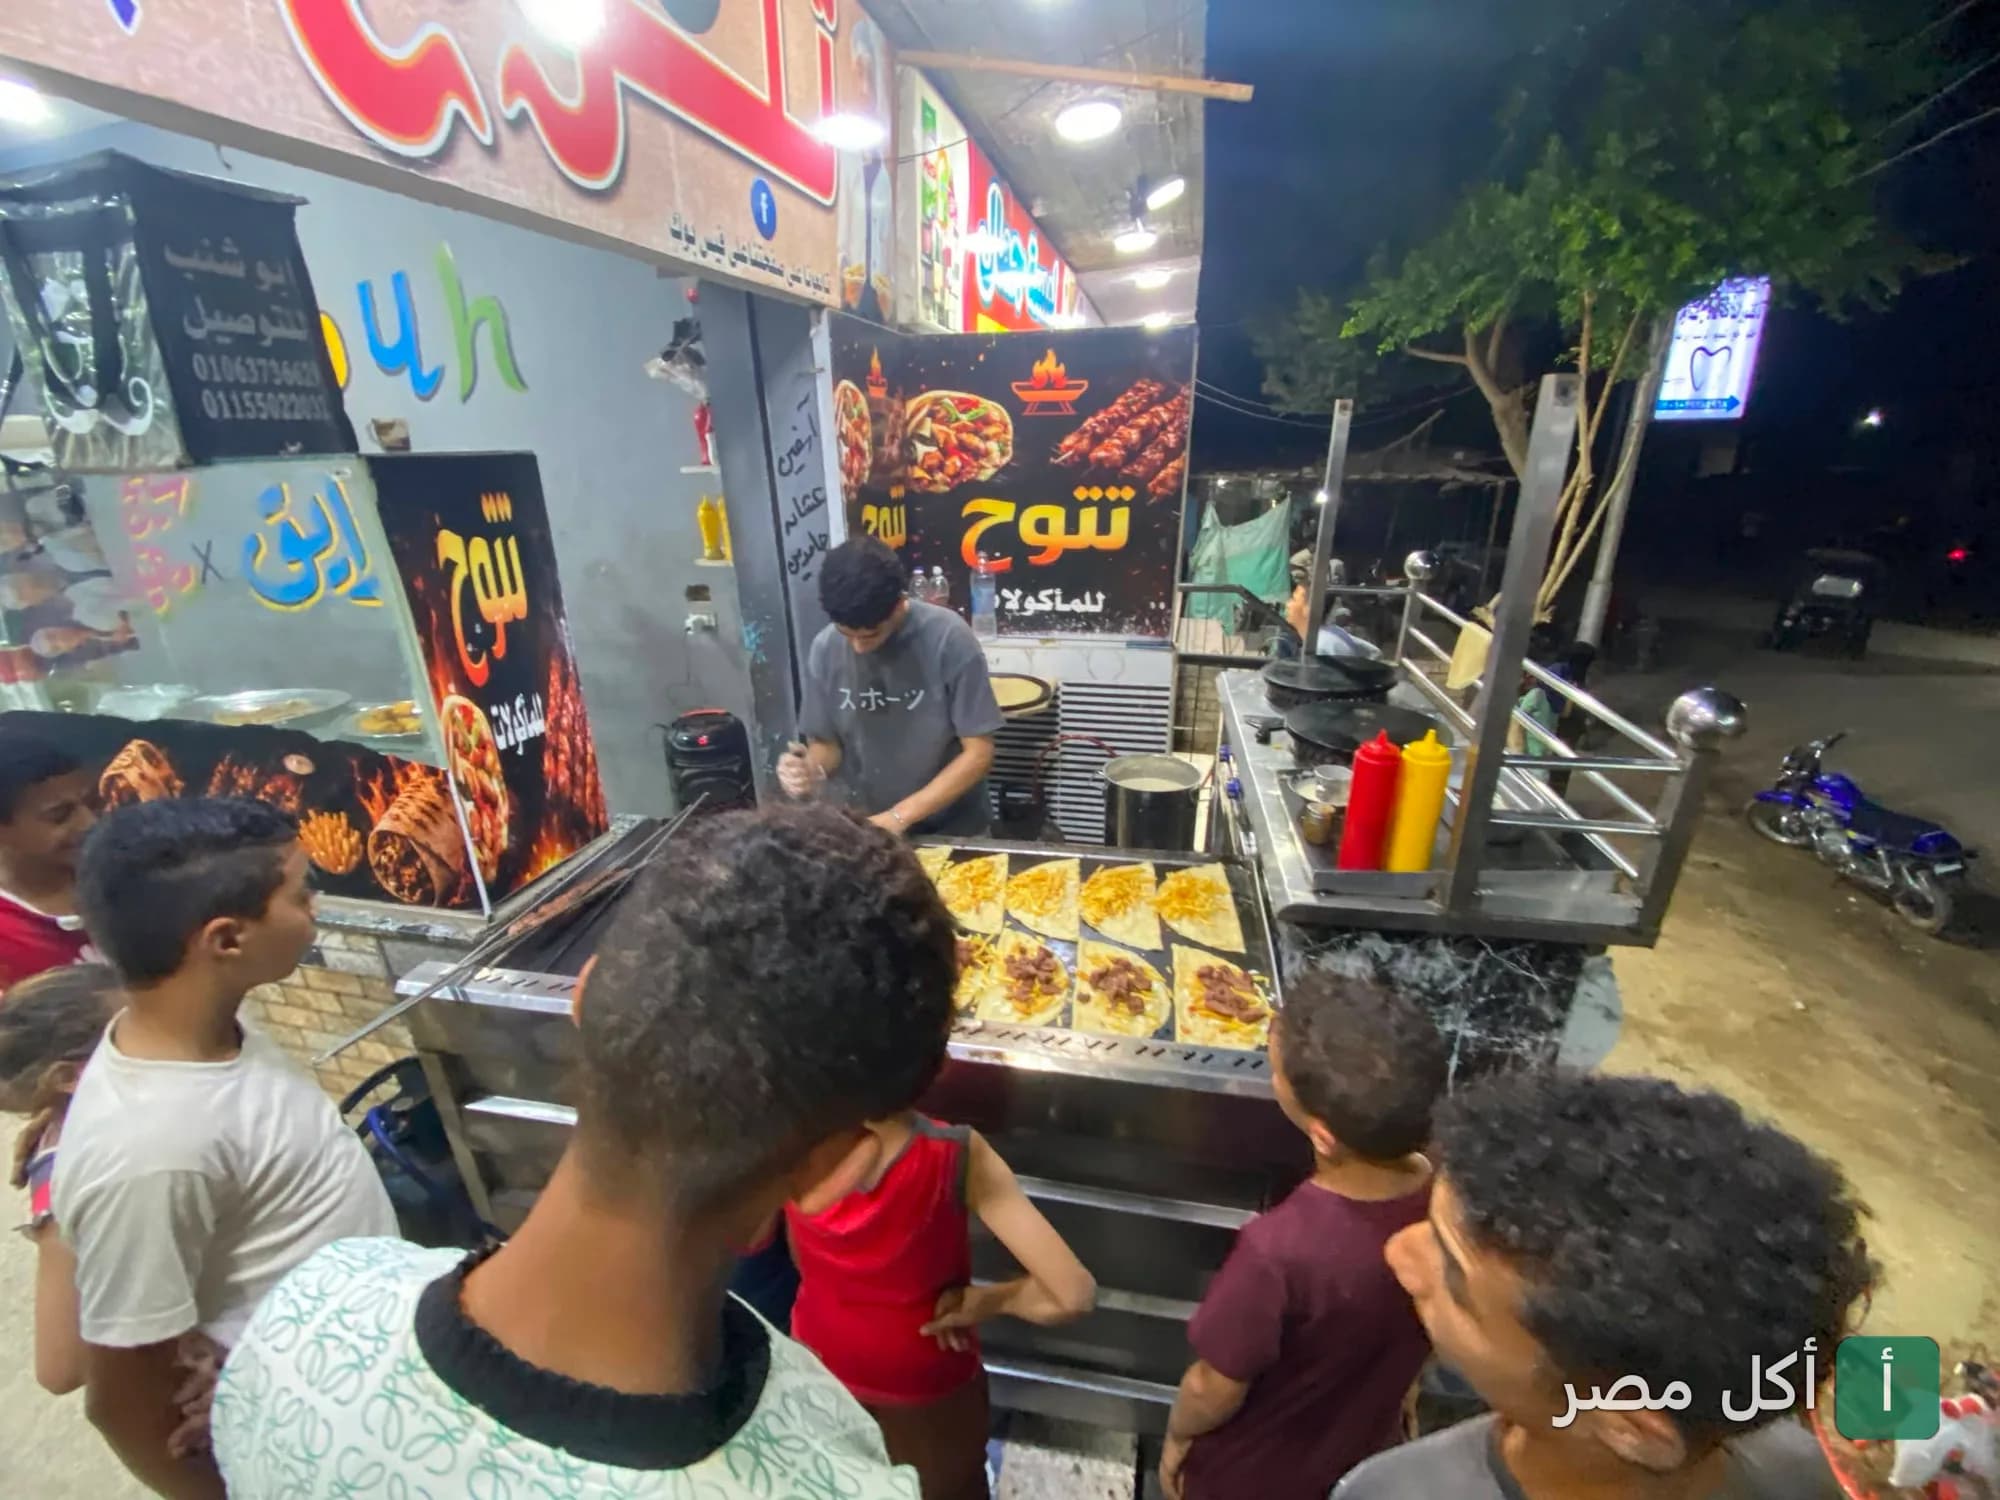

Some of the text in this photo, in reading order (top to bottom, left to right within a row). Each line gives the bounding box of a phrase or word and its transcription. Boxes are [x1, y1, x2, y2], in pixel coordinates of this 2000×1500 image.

[162, 235, 247, 281] شنب
[700, 225, 727, 264] فيس
[994, 588, 1106, 617] للمأكولا
